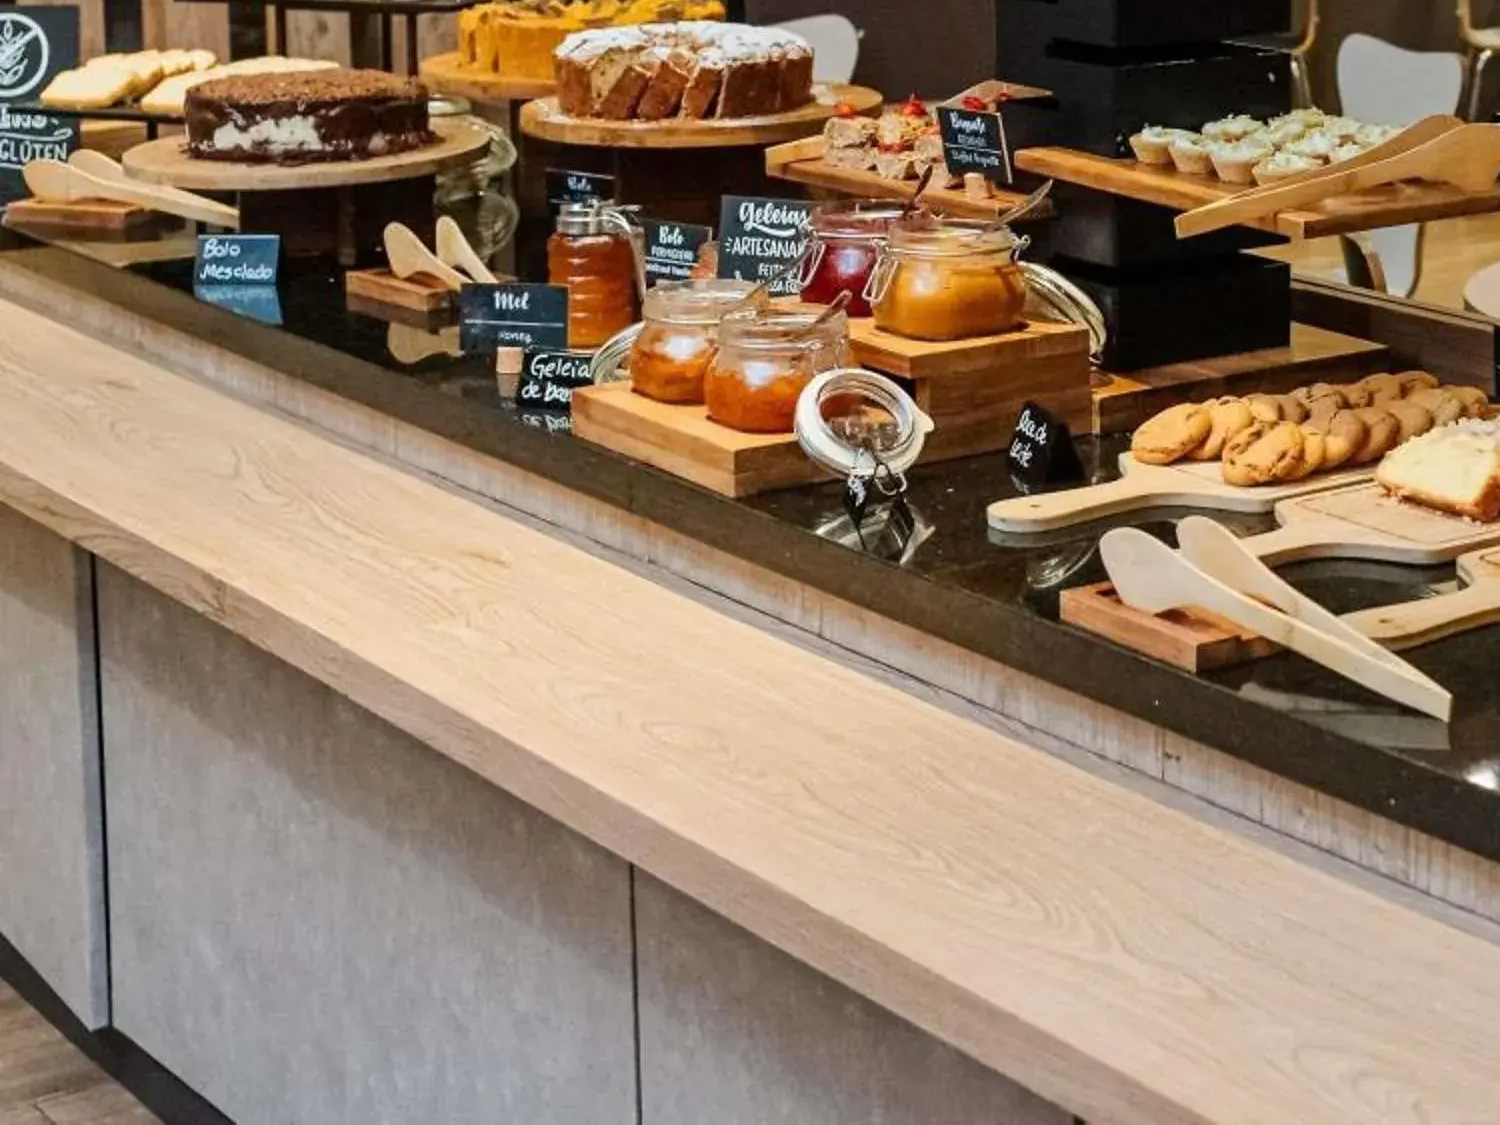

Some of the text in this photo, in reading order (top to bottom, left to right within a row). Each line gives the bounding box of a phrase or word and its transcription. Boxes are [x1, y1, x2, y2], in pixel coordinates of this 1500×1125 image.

[659, 225, 684, 245] Bolo
[203, 238, 241, 259] Bolo
[494, 291, 530, 310] Mel
[530, 354, 592, 379] Geleia
[521, 380, 542, 399] de
